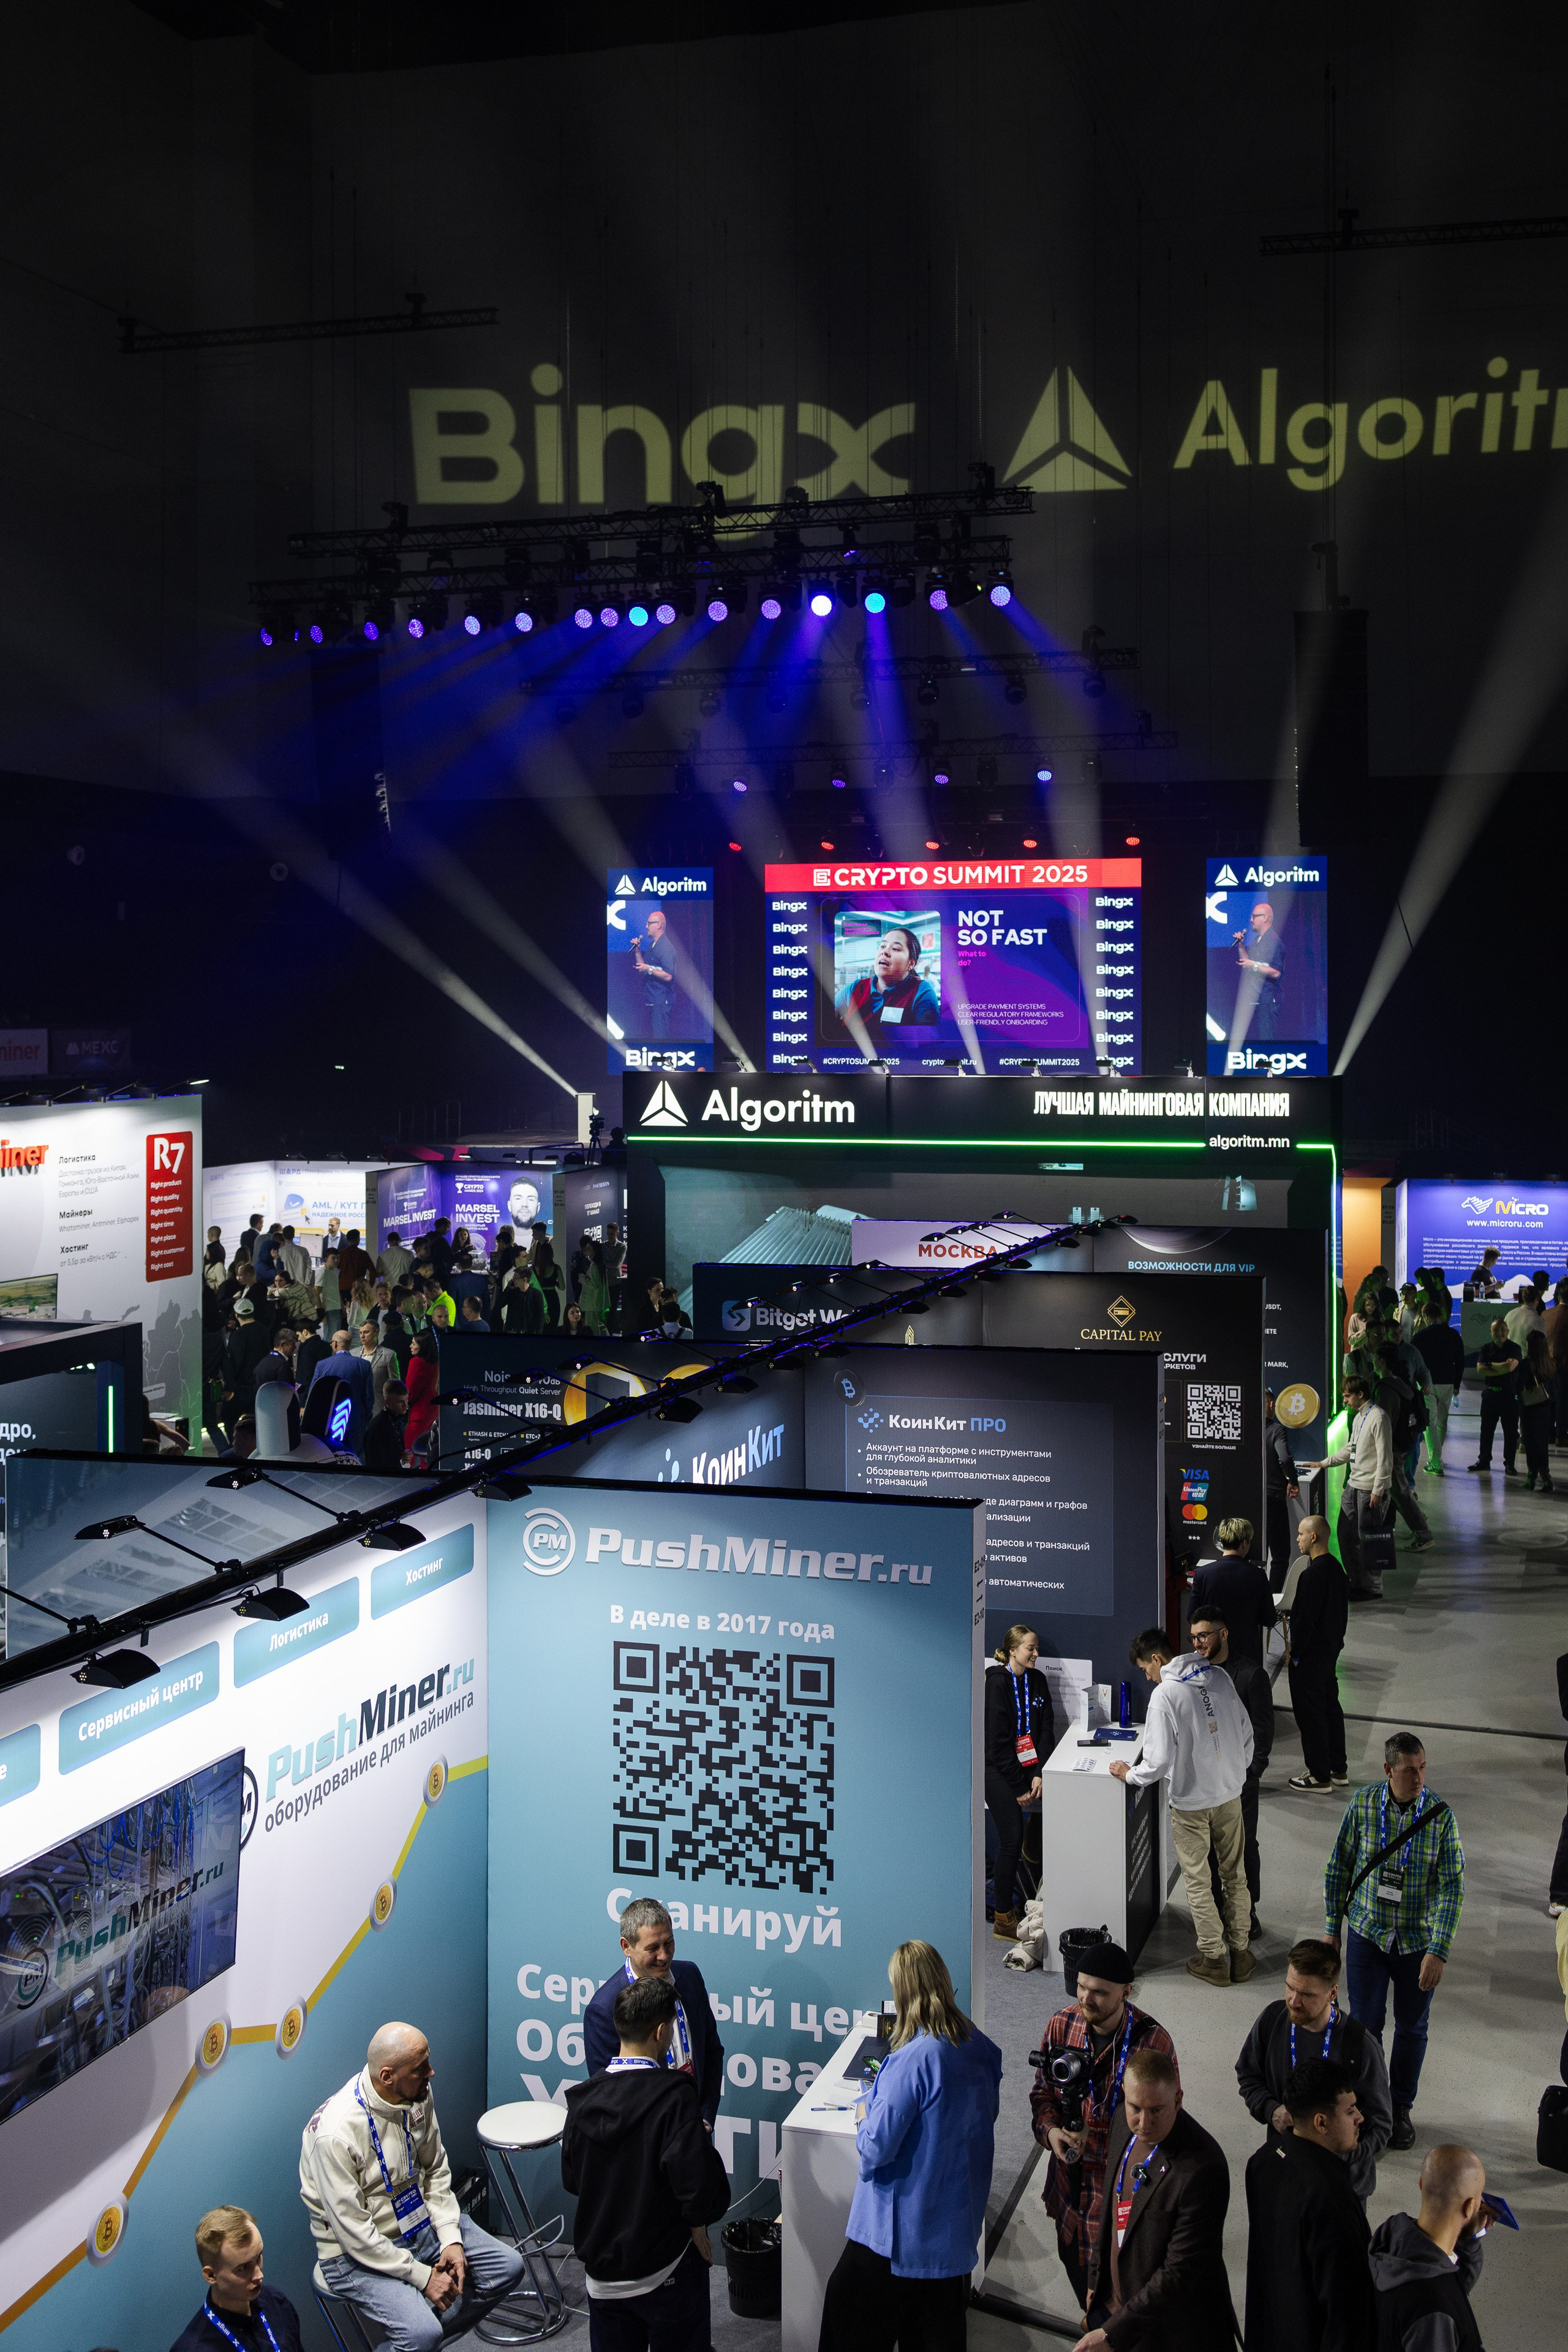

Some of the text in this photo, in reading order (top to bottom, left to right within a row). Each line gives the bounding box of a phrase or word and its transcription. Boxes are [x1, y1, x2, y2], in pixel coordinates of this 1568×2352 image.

[1173, 356, 1568, 490] Algorit
[409, 363, 915, 540] Bingx
[834, 865, 1088, 886] CRYPTO SUMMIT 2025
[1245, 865, 1319, 887] Algoritm
[641, 876, 707, 896] Algoritm
[772, 900, 807, 913] Bingx
[1096, 896, 1134, 908] Bingx
[958, 910, 1004, 927] NOT
[1096, 919, 1134, 931] Bingx
[773, 922, 807, 935] Bingx
[957, 929, 1047, 946] SO FAST
[773, 944, 807, 956] Bingx
[1096, 941, 1134, 954] Bingx
[773, 966, 807, 978] Bingx
[1096, 964, 1134, 976] Bingx
[773, 988, 807, 1000] Bingx
[1096, 987, 1134, 1000] Bingx
[773, 1009, 807, 1022] Bingx
[1096, 1009, 1134, 1022] Bingx
[773, 1031, 807, 1044] Bingx
[1096, 1032, 1134, 1045] Bingx
[81, 1041, 118, 1054] MEXC
[625, 1047, 695, 1071] Bingx
[1228, 1048, 1306, 1074] Bingx
[1033, 1088, 1290, 1117] ЛУЧШАЯ МАЙНИНГОВАЯ КОМПАНИЯ
[701, 1087, 856, 1132] Algoritm
[1209, 1135, 1290, 1150] algoritm.mn
[59, 1154, 96, 1164] Логистика
[154, 1137, 185, 1174] R7
[59, 1208, 92, 1219] Майнеры
[455, 1204, 500, 1213] MARSEL
[383, 1209, 436, 1227] MARSEL INVEST
[456, 1213, 500, 1223] INVEST
[1466, 1219, 1544, 1228] www.microru.com
[60, 1244, 89, 1254] Хостинг
[919, 1244, 997, 1259] МОСКВА
[1128, 1261, 1212, 1272] ВОЗМОЖНОСТИ
[1214, 1264, 1235, 1273] ДЛЯ
[756, 1308, 816, 1330] Bitget
[1080, 1329, 1162, 1342] CAPITAL PAY
[480, 1385, 517, 1394] Throughput
[519, 1387, 538, 1395] Quiet
[463, 1401, 562, 1420] Jasminer X16-Q
[970, 1417, 1006, 1433] ПРО
[866, 1442, 903, 1454] Аккаунт
[919, 1446, 969, 1457] платформе
[979, 1449, 1052, 1460] инструментами
[884, 1454, 925, 1465] глубокой
[927, 1457, 976, 1465] аналитики
[866, 1466, 1050, 1484] Обозреватель криптовалютных адресов
[1181, 1469, 1210, 1480] VISA
[874, 1478, 927, 1488] транзакций
[1183, 1487, 1207, 1495] UnionPay
[999, 1499, 1044, 1508] диаграмм
[1054, 1501, 1087, 1510] графов
[985, 1514, 1031, 1523] ализации
[986, 1539, 1024, 1548] адресов
[1035, 1541, 1090, 1551] транзакций
[532, 1527, 933, 1586] PM PushMiner.ru
[405, 1556, 443, 1585] Хостинг
[989, 1579, 1065, 1589] автоматических
[610, 1604, 835, 1643] В деле в 2017 года
[270, 1613, 329, 1653] Логистика
[78, 1669, 204, 1743] Сервисный центр
[266, 1658, 474, 1804] PushMiner.ru
[265, 1691, 473, 1833] оборудование для майнинга
[606, 1887, 842, 1954] Санируй
